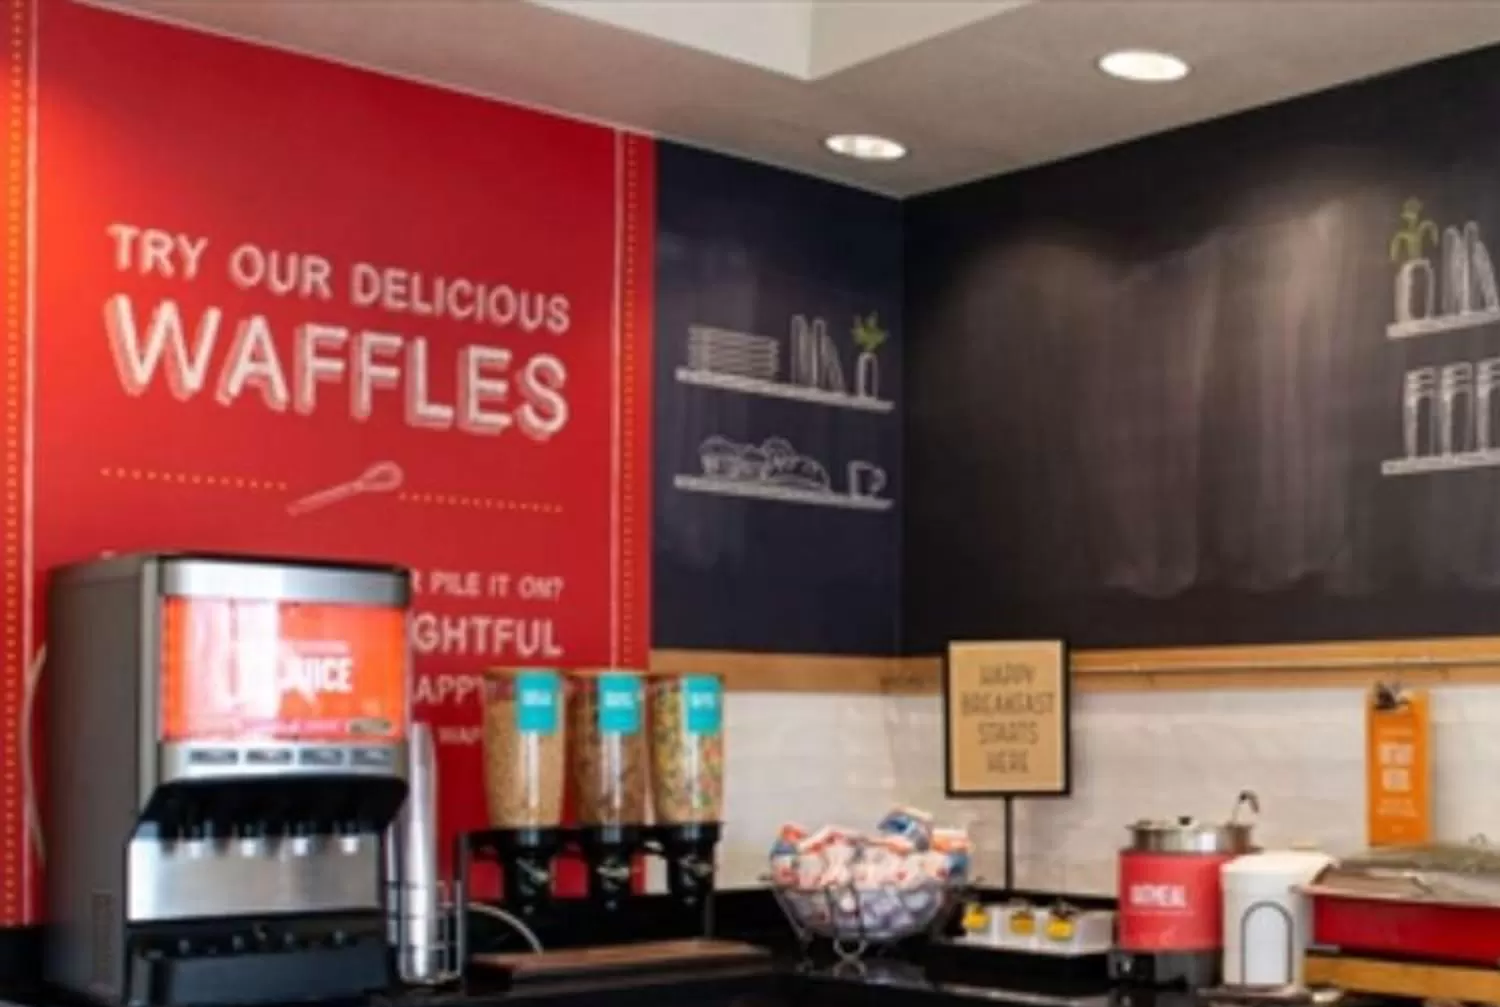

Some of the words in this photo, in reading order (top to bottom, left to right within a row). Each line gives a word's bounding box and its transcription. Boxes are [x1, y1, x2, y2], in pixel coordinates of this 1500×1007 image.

[107, 223, 208, 279] TRY
[229, 244, 332, 299] OUR
[351, 262, 571, 334] DELICIOUS
[103, 293, 571, 442] WAFFLES
[429, 571, 480, 597] PILE
[488, 573, 510, 598] IT
[411, 612, 563, 658] GHTFUL
